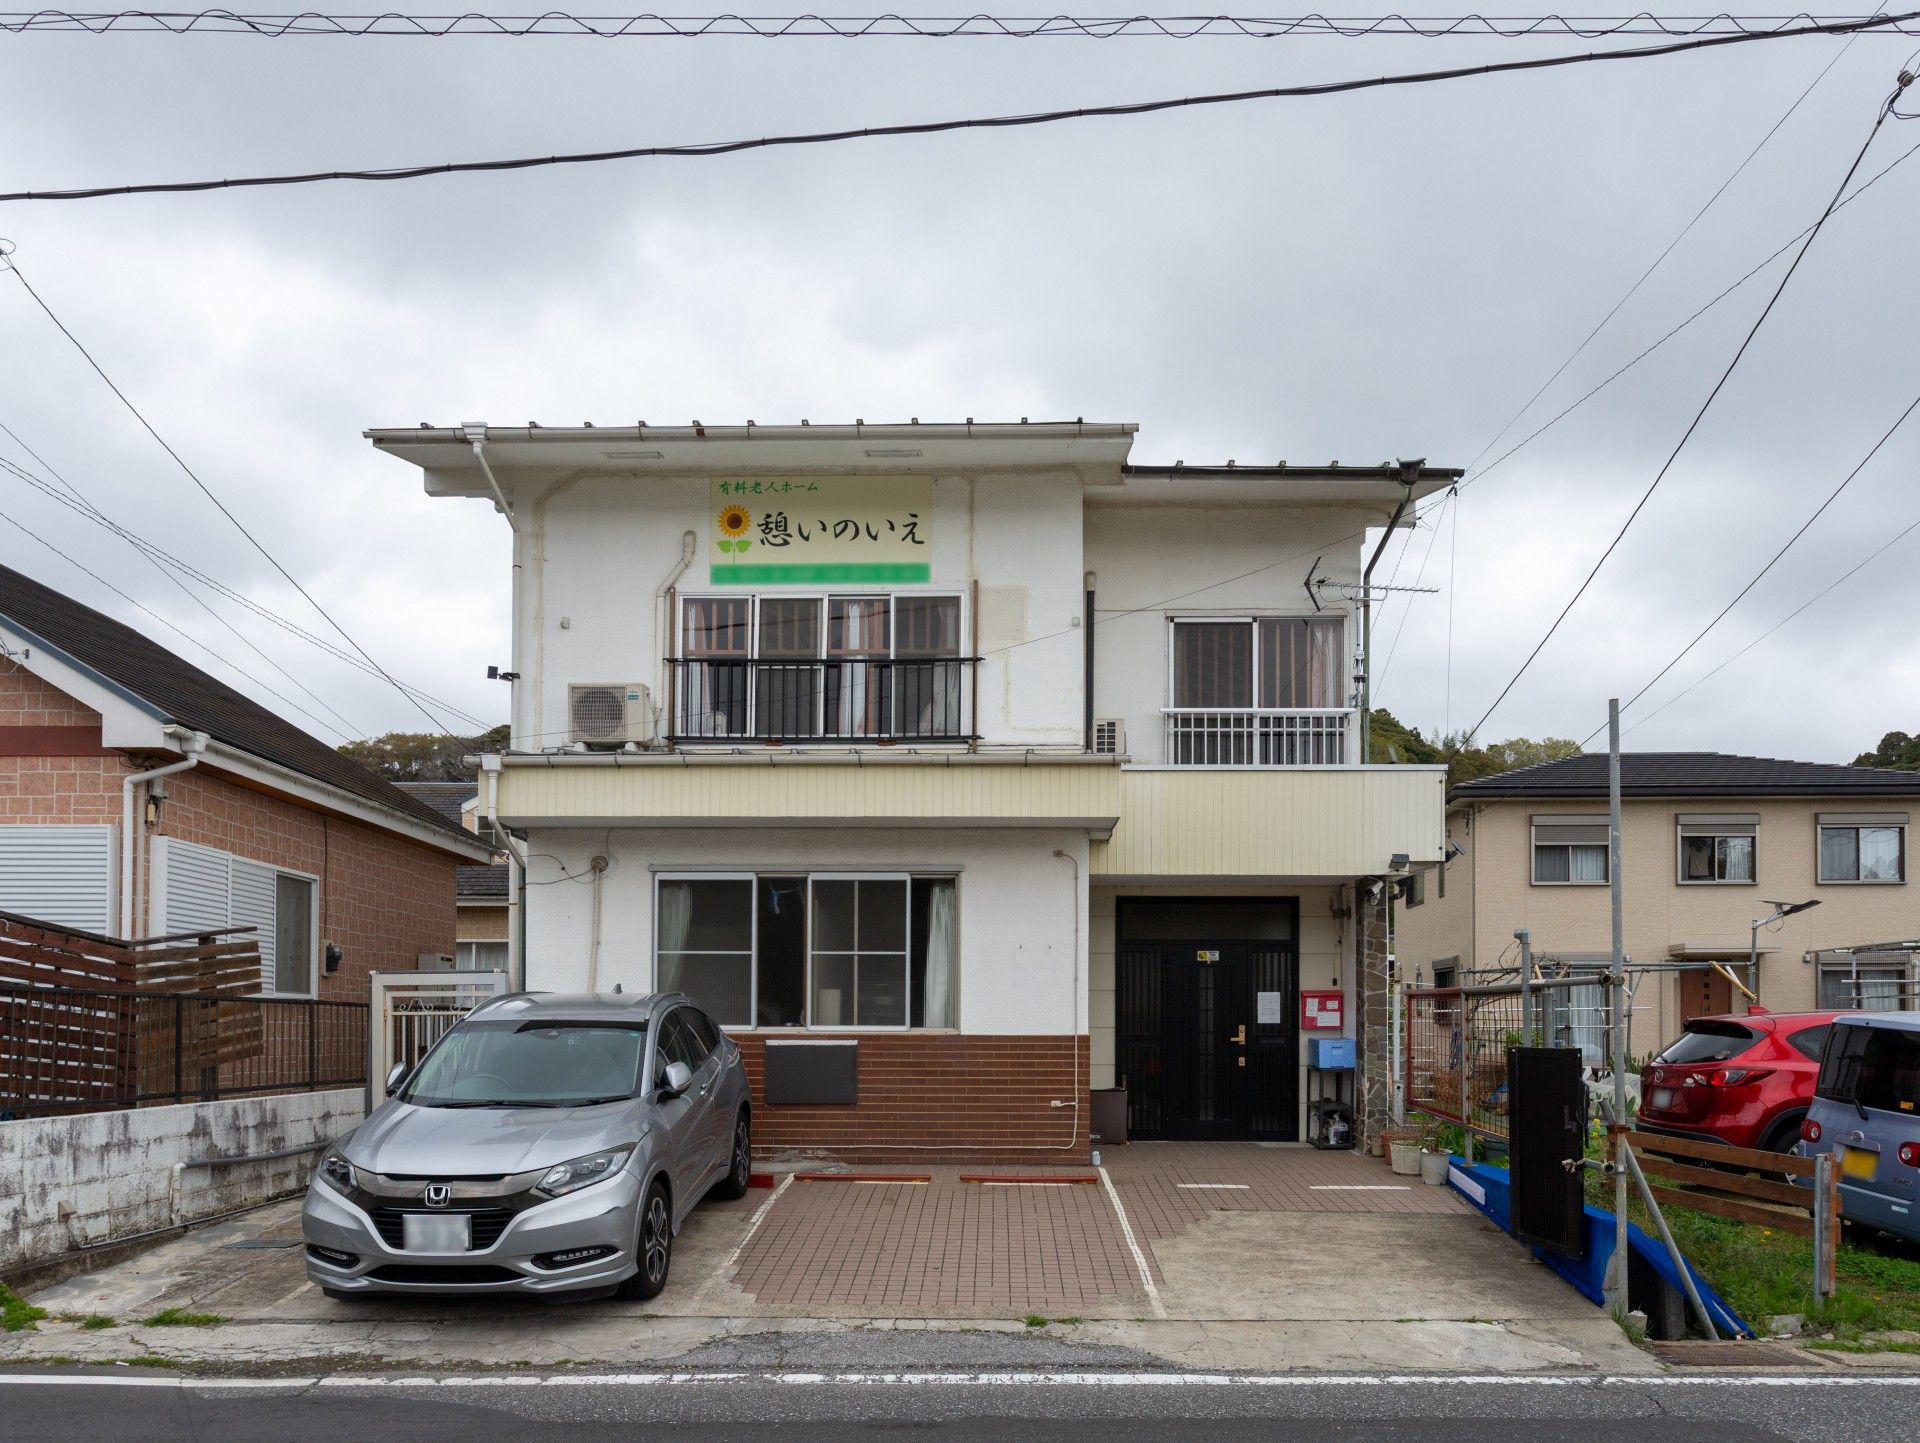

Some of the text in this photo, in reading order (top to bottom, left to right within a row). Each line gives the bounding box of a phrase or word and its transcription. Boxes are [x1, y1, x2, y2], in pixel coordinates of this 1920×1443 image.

[719, 480, 819, 496] 有料老人ホーム
[756, 511, 925, 547] 憩いのいえ
